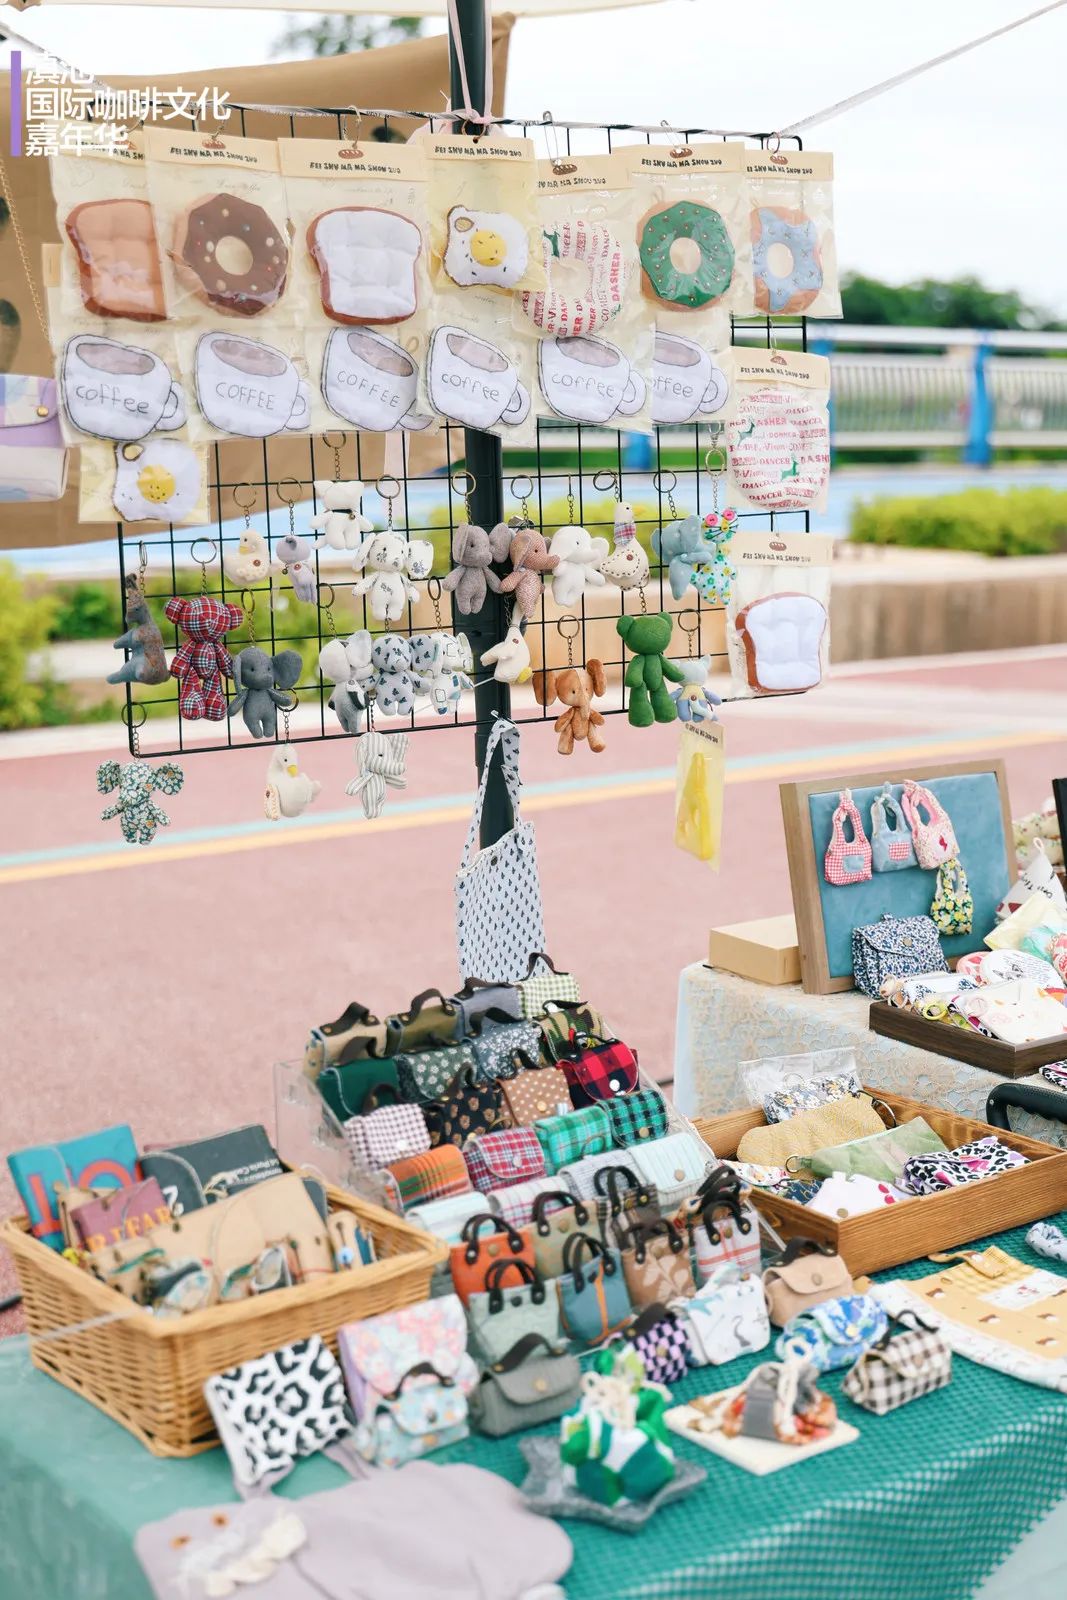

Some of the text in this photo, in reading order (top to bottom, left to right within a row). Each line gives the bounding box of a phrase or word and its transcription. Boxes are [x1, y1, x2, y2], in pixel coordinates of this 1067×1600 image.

[609, 252, 621, 302] DASHER
[75, 384, 149, 414] coffee
[215, 381, 276, 410] COFFEE
[337, 370, 401, 408] COFFEE
[441, 372, 500, 402] coffee
